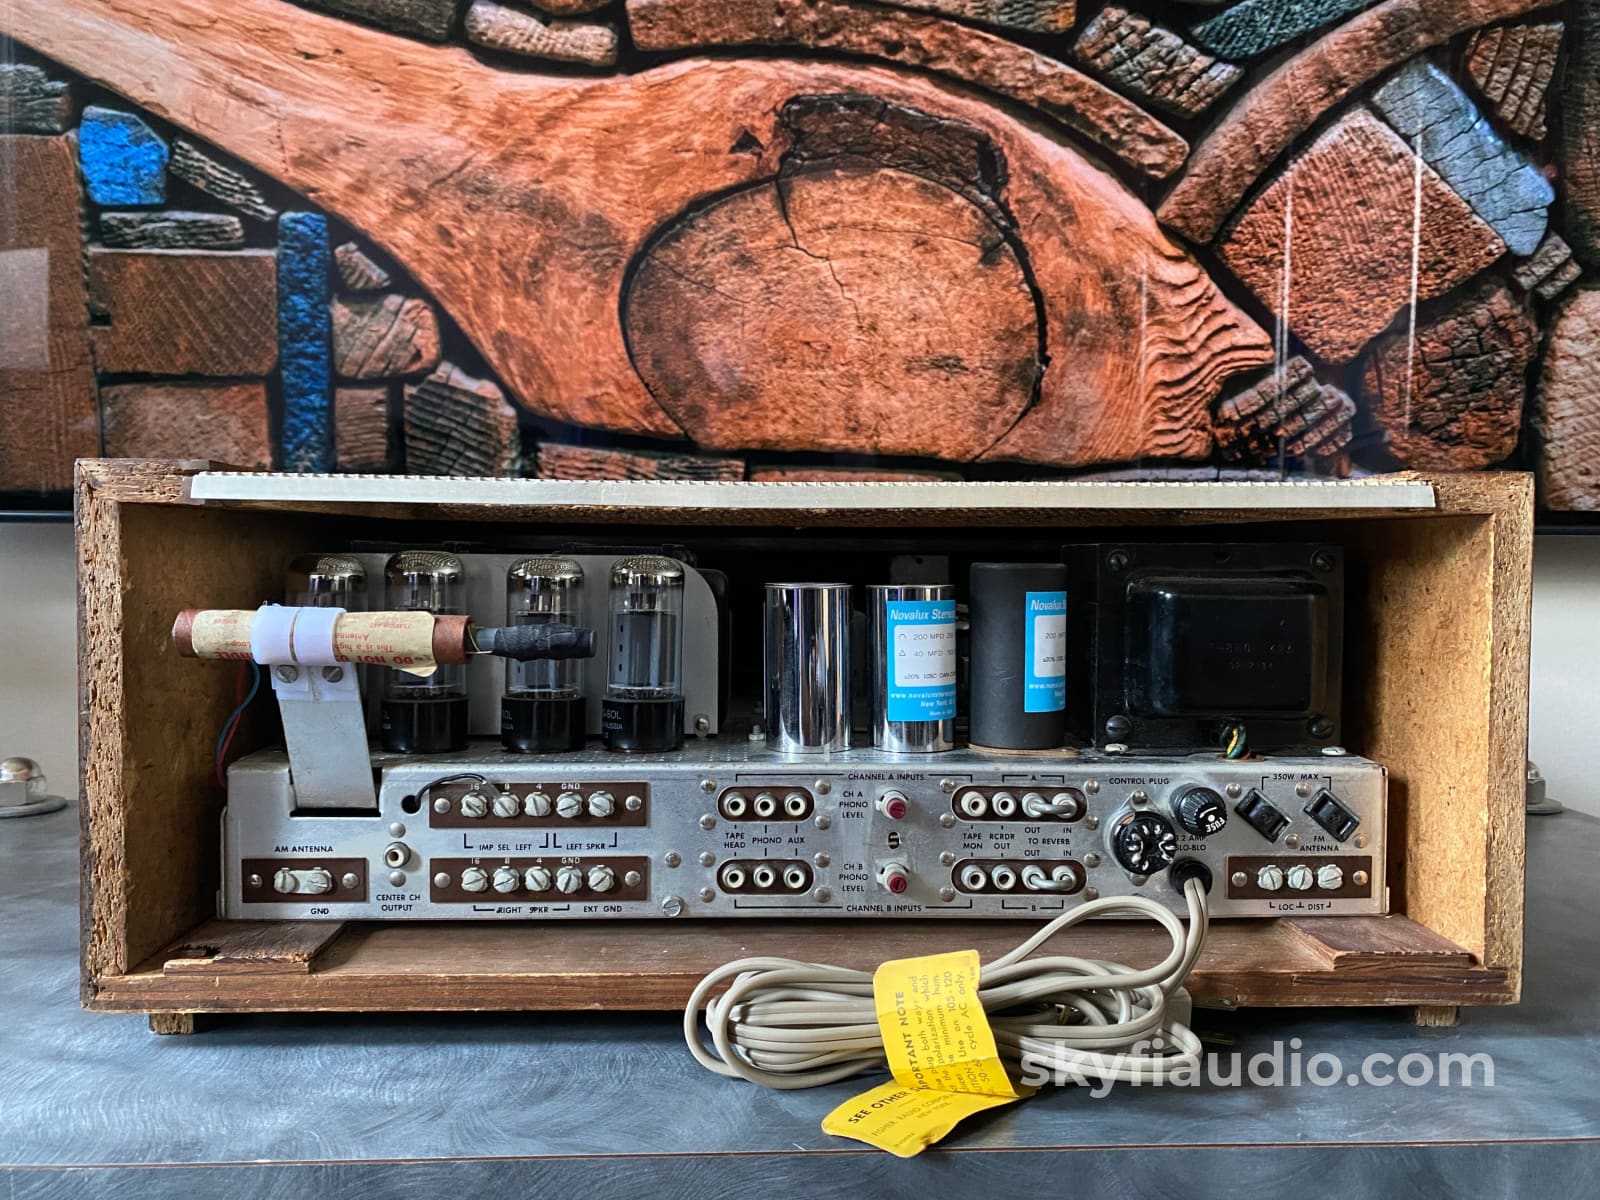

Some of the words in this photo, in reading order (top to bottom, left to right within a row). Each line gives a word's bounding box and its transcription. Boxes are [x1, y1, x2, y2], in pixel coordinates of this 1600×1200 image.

[891, 609, 928, 620] Novalux
[930, 632, 944, 640] MFD
[377, 644, 393, 653] This
[357, 655, 386, 664] NOT
[392, 656, 414, 664] DO
[1109, 777, 1146, 785] CONTROL
[1149, 777, 1170, 785] PLUG
[1206, 817, 1226, 832] FUSE
[909, 976, 918, 992] and
[920, 974, 930, 1002] which
[896, 992, 910, 1026] NOTE
[960, 1002, 970, 1018] AC
[937, 1004, 951, 1046] minimum
[954, 1020, 961, 1032] on
[920, 1030, 930, 1051] both
[926, 1009, 945, 1064] polarization
[965, 1025, 978, 1050] cycle
[956, 1040, 967, 1058] Use
[902, 1032, 930, 1090] PORTANT
[926, 1056, 938, 1074] plug
[848, 1109, 872, 1124] SEE
[872, 1091, 910, 1109] OTHER
